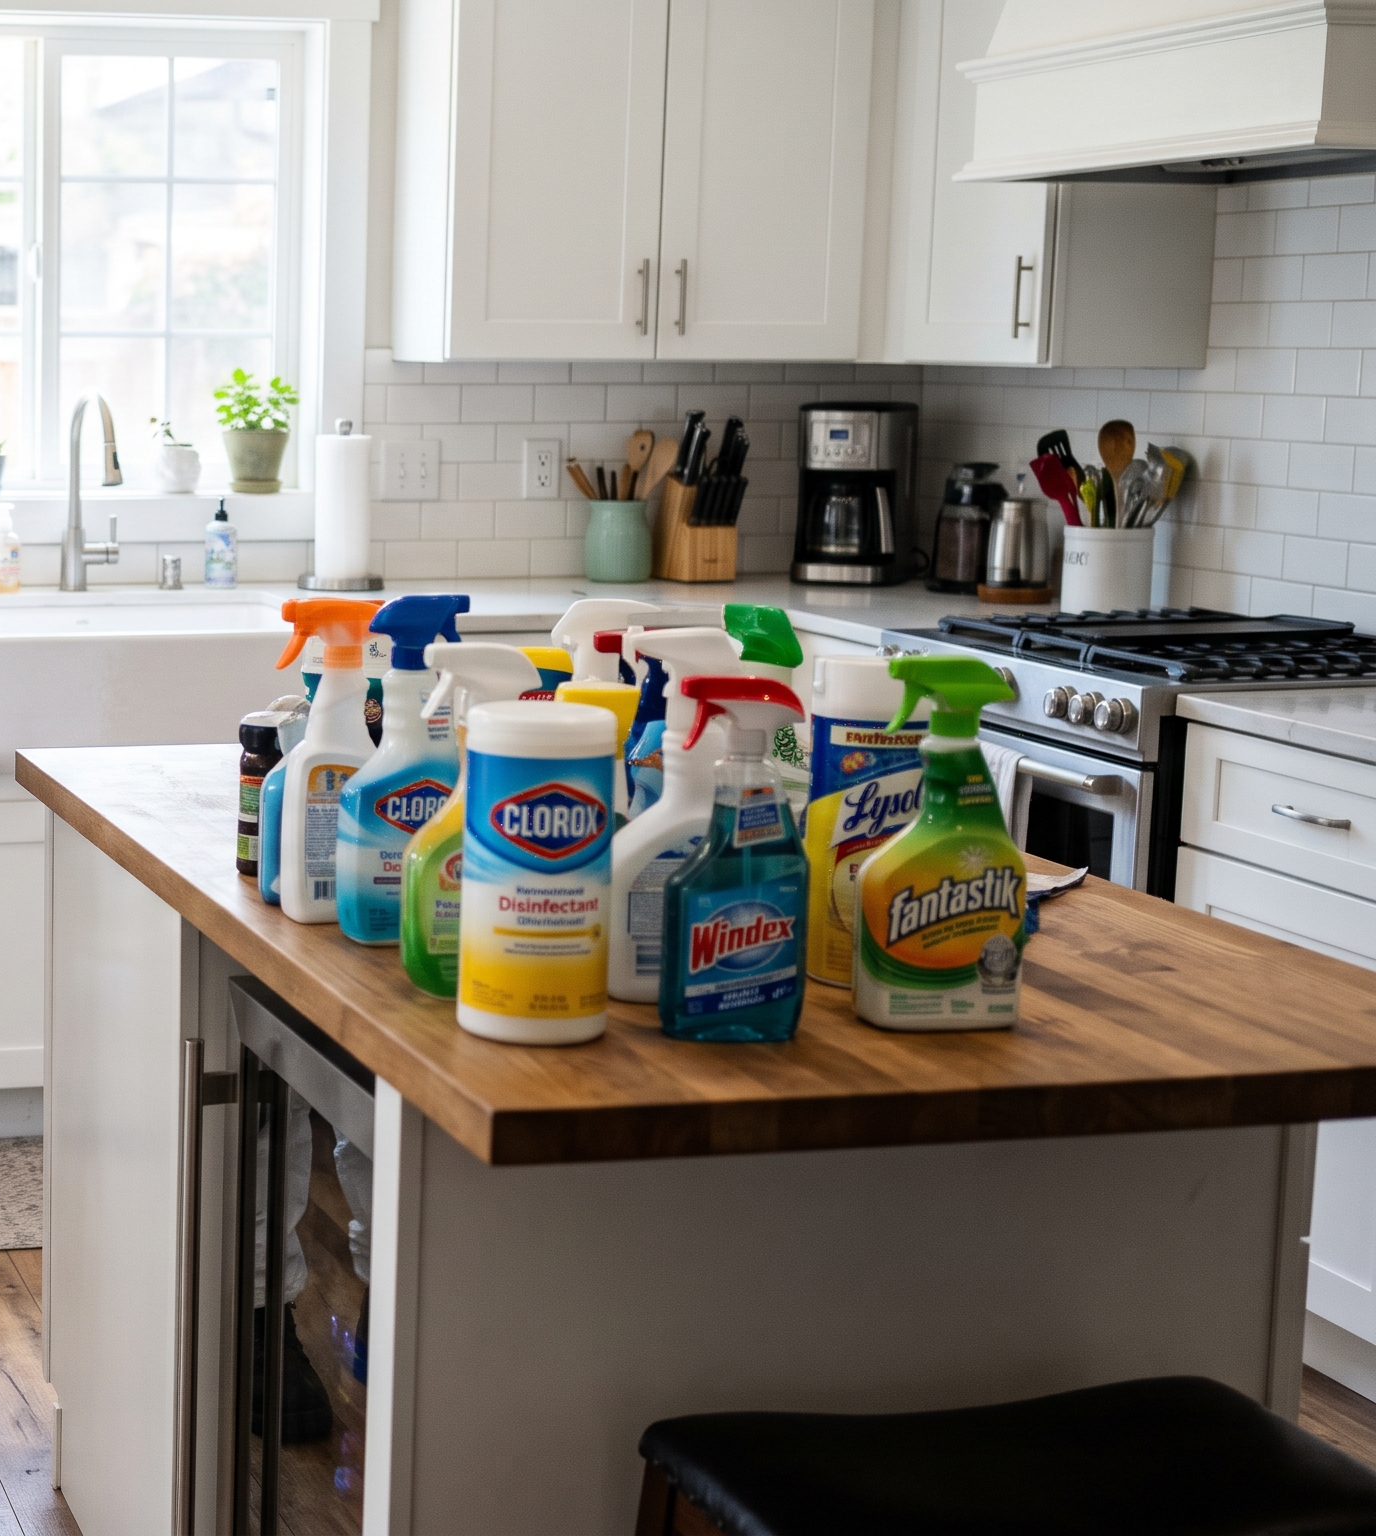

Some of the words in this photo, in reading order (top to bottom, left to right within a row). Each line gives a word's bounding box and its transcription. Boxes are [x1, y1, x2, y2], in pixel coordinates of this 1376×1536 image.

[503, 803, 599, 838] CLOROX
[843, 781, 923, 836] Lysol
[887, 867, 1021, 946] fantastik
[689, 914, 795, 975] Windex
